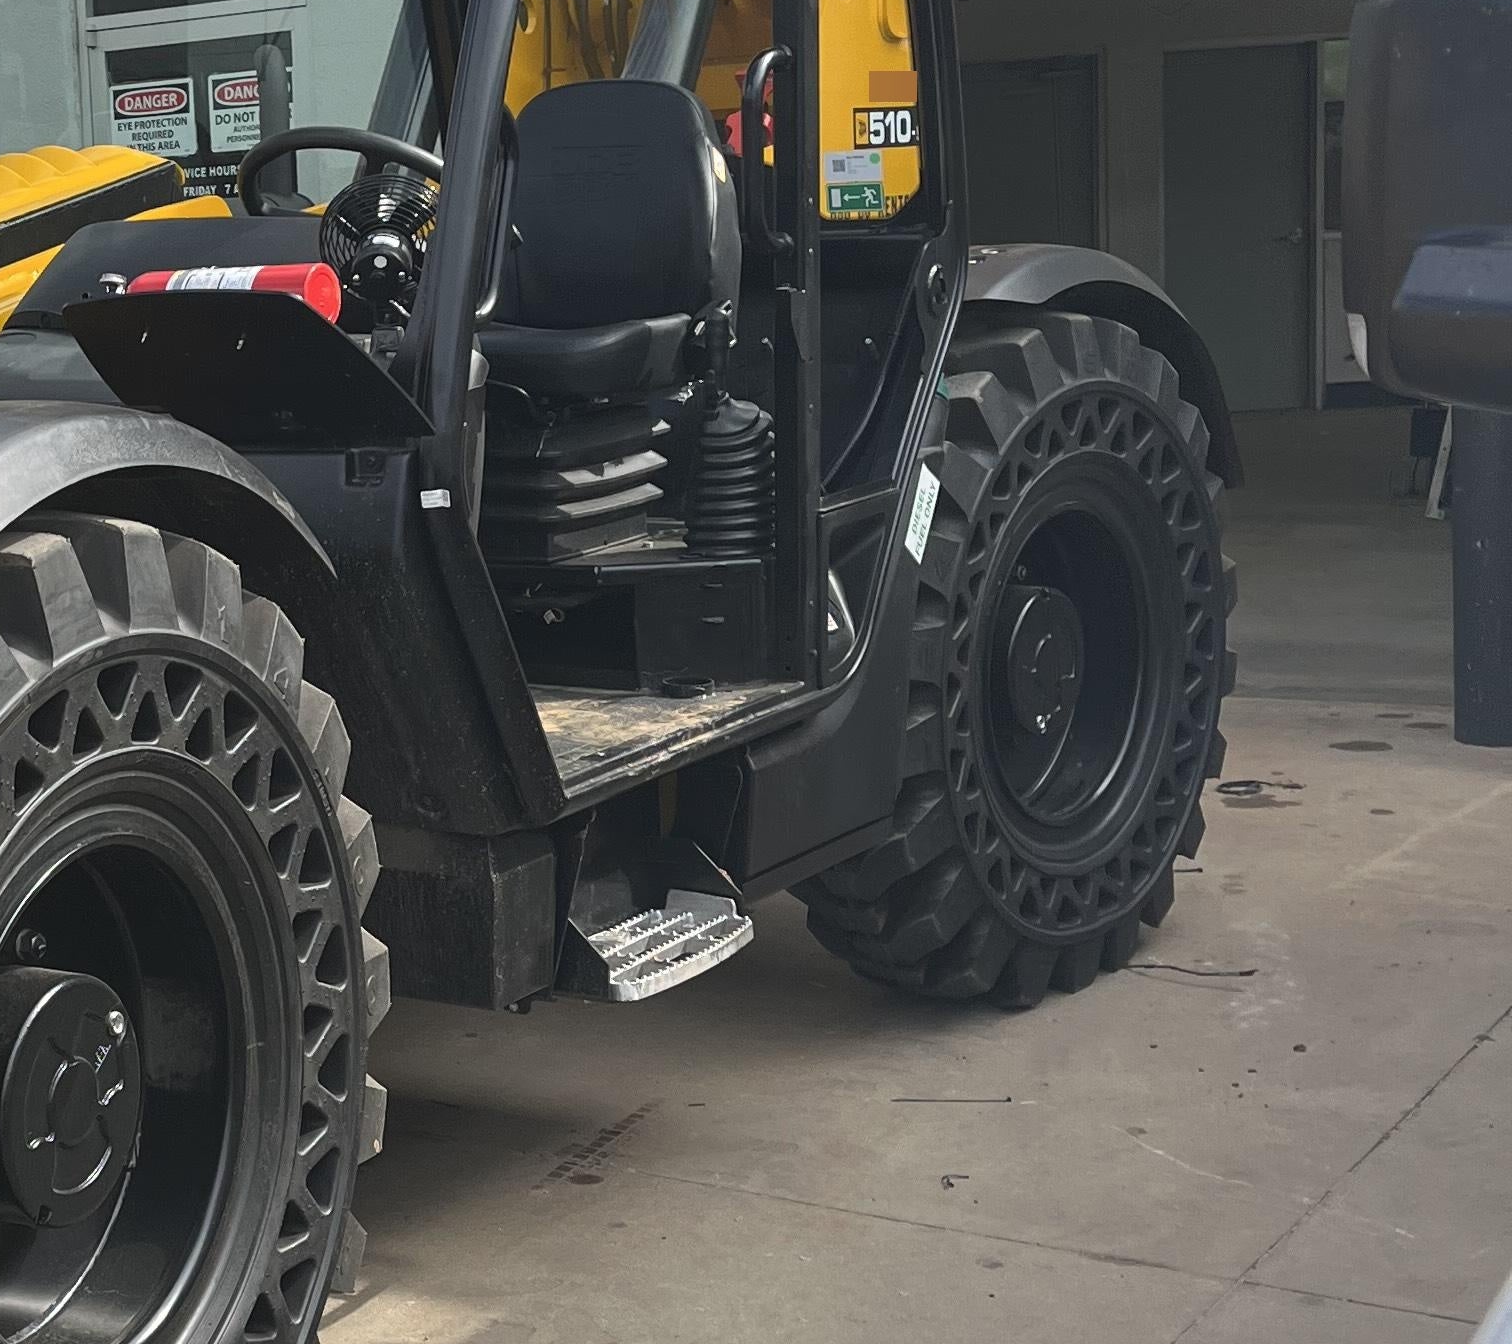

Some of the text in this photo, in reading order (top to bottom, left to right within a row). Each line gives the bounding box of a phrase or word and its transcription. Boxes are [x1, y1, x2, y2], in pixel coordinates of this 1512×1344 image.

[124, 92, 178, 111] DANGER
[117, 116, 188, 132] EYE PROTECTION
[215, 111, 256, 126] DO NOT
[131, 129, 174, 142] REQUIRED
[136, 141, 156, 152] THIS
[157, 140, 181, 151] AREA
[183, 185, 217, 197] FRIDAY
[224, 184, 231, 194] 7
[911, 488, 926, 535] DIESEL
[914, 480, 937, 557] FUEL ONLY
